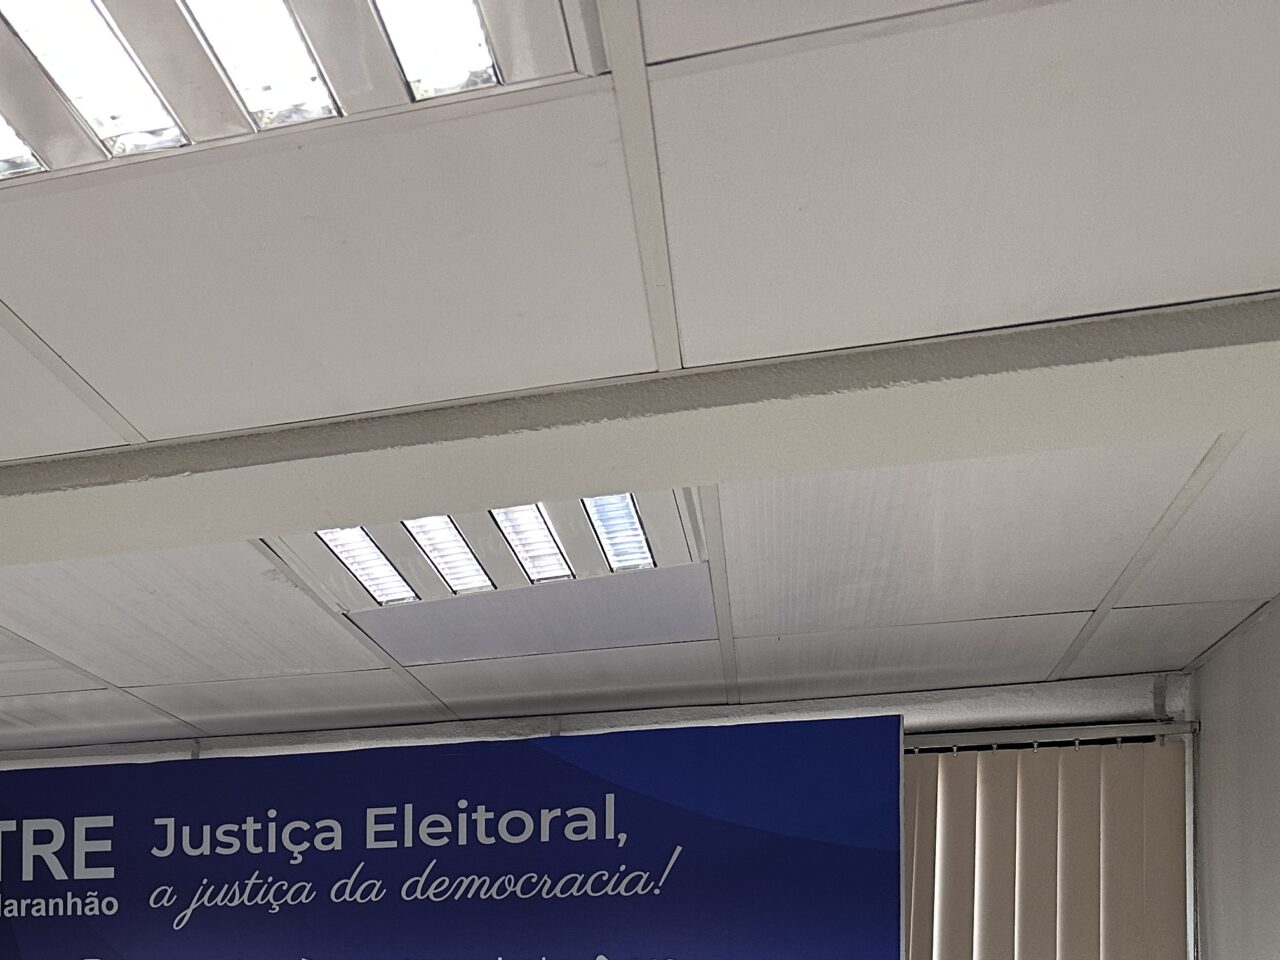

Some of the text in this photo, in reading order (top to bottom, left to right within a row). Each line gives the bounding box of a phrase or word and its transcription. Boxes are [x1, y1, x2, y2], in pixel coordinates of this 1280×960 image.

[150, 793, 628, 865] Justiça Eleitoral,
[148, 845, 683, 931] a justiça da democracia!
